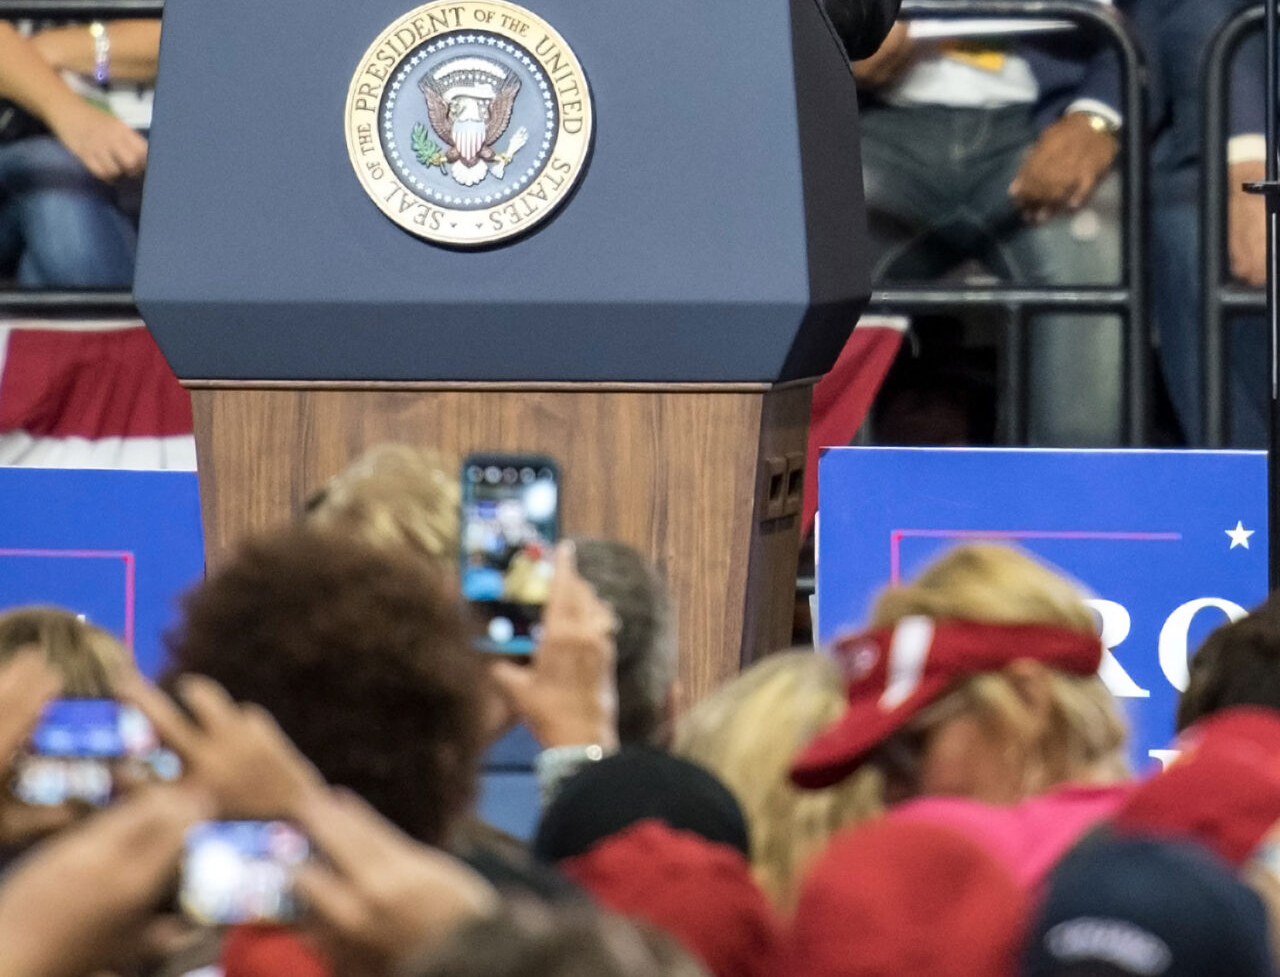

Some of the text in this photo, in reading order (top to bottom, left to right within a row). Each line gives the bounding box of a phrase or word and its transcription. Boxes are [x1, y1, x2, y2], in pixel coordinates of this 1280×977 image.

[355, 6, 583, 231] SEAL OF THE PRESIDENT OF THE UNITED STATES
